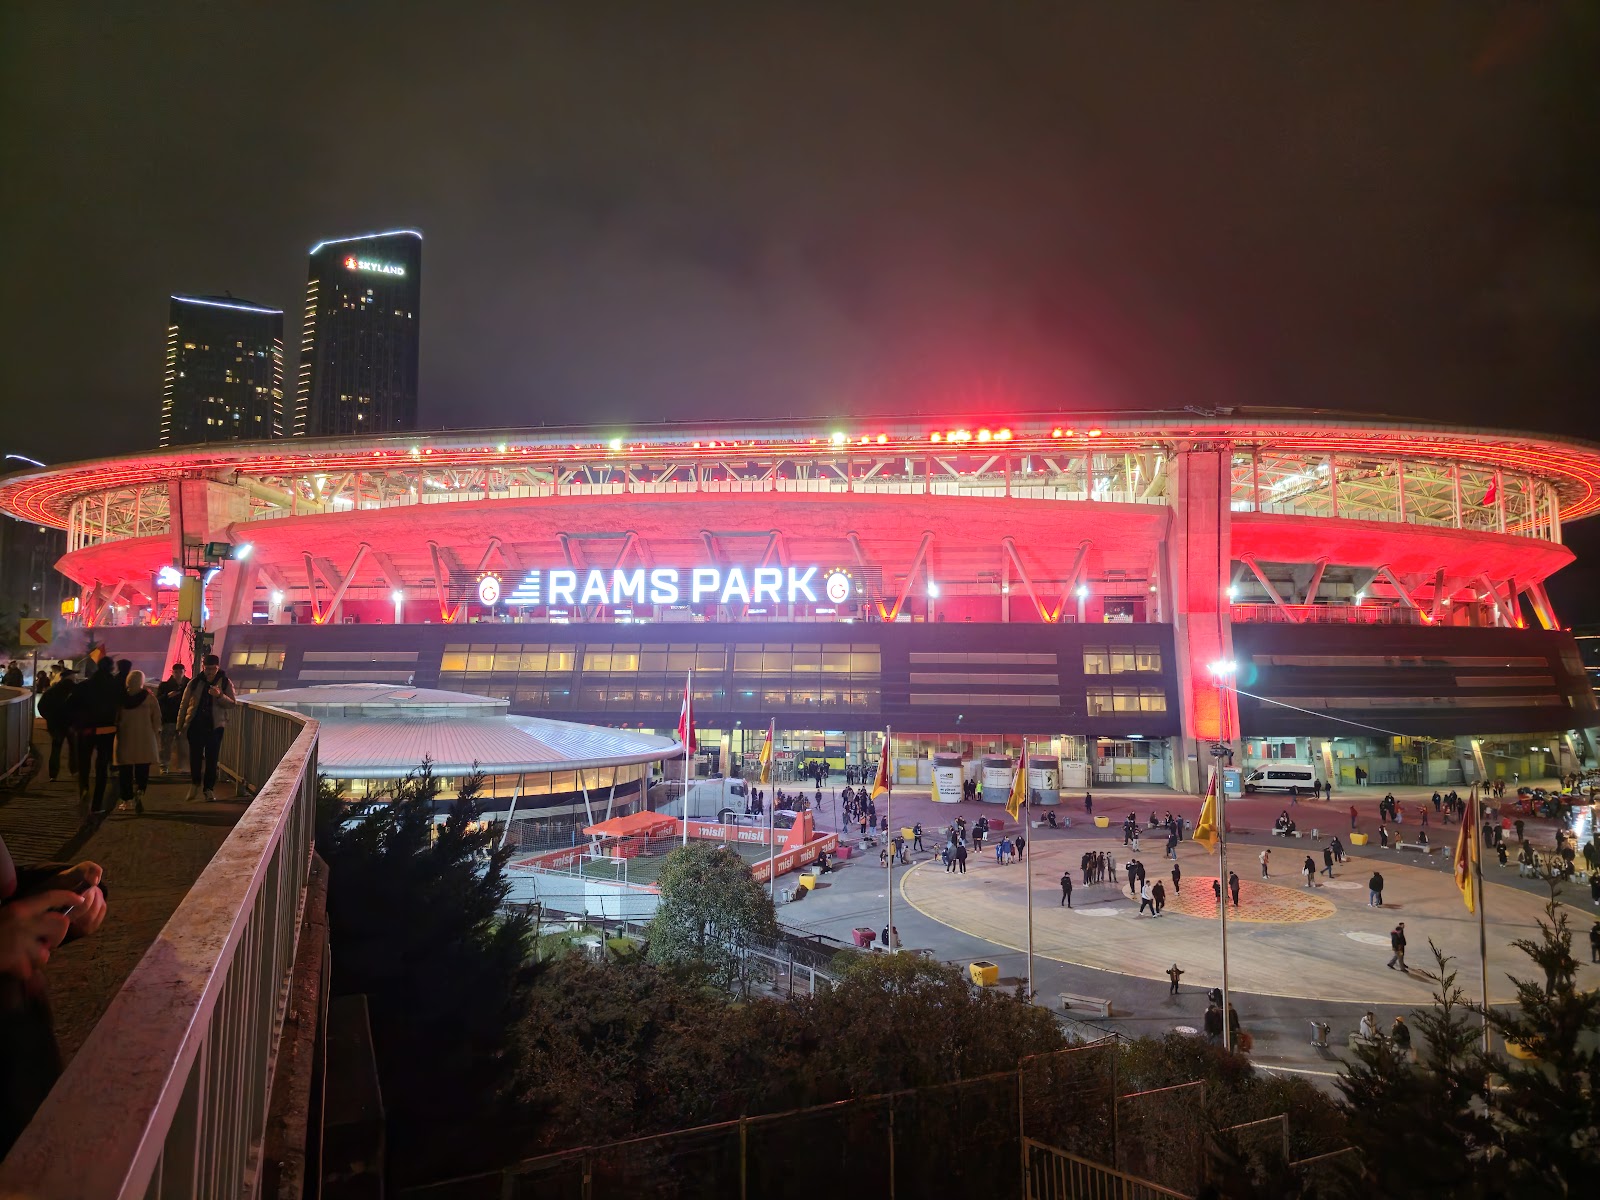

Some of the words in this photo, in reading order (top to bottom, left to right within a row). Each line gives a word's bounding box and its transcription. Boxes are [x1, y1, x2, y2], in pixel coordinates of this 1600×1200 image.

[358, 261, 404, 275] SKYLAND
[549, 569, 679, 604] RAMS
[692, 567, 818, 603] PARK
[698, 827, 725, 838] misli
[738, 831, 764, 841] misli
[801, 847, 815, 862] misli
[778, 856, 793, 871] misli
